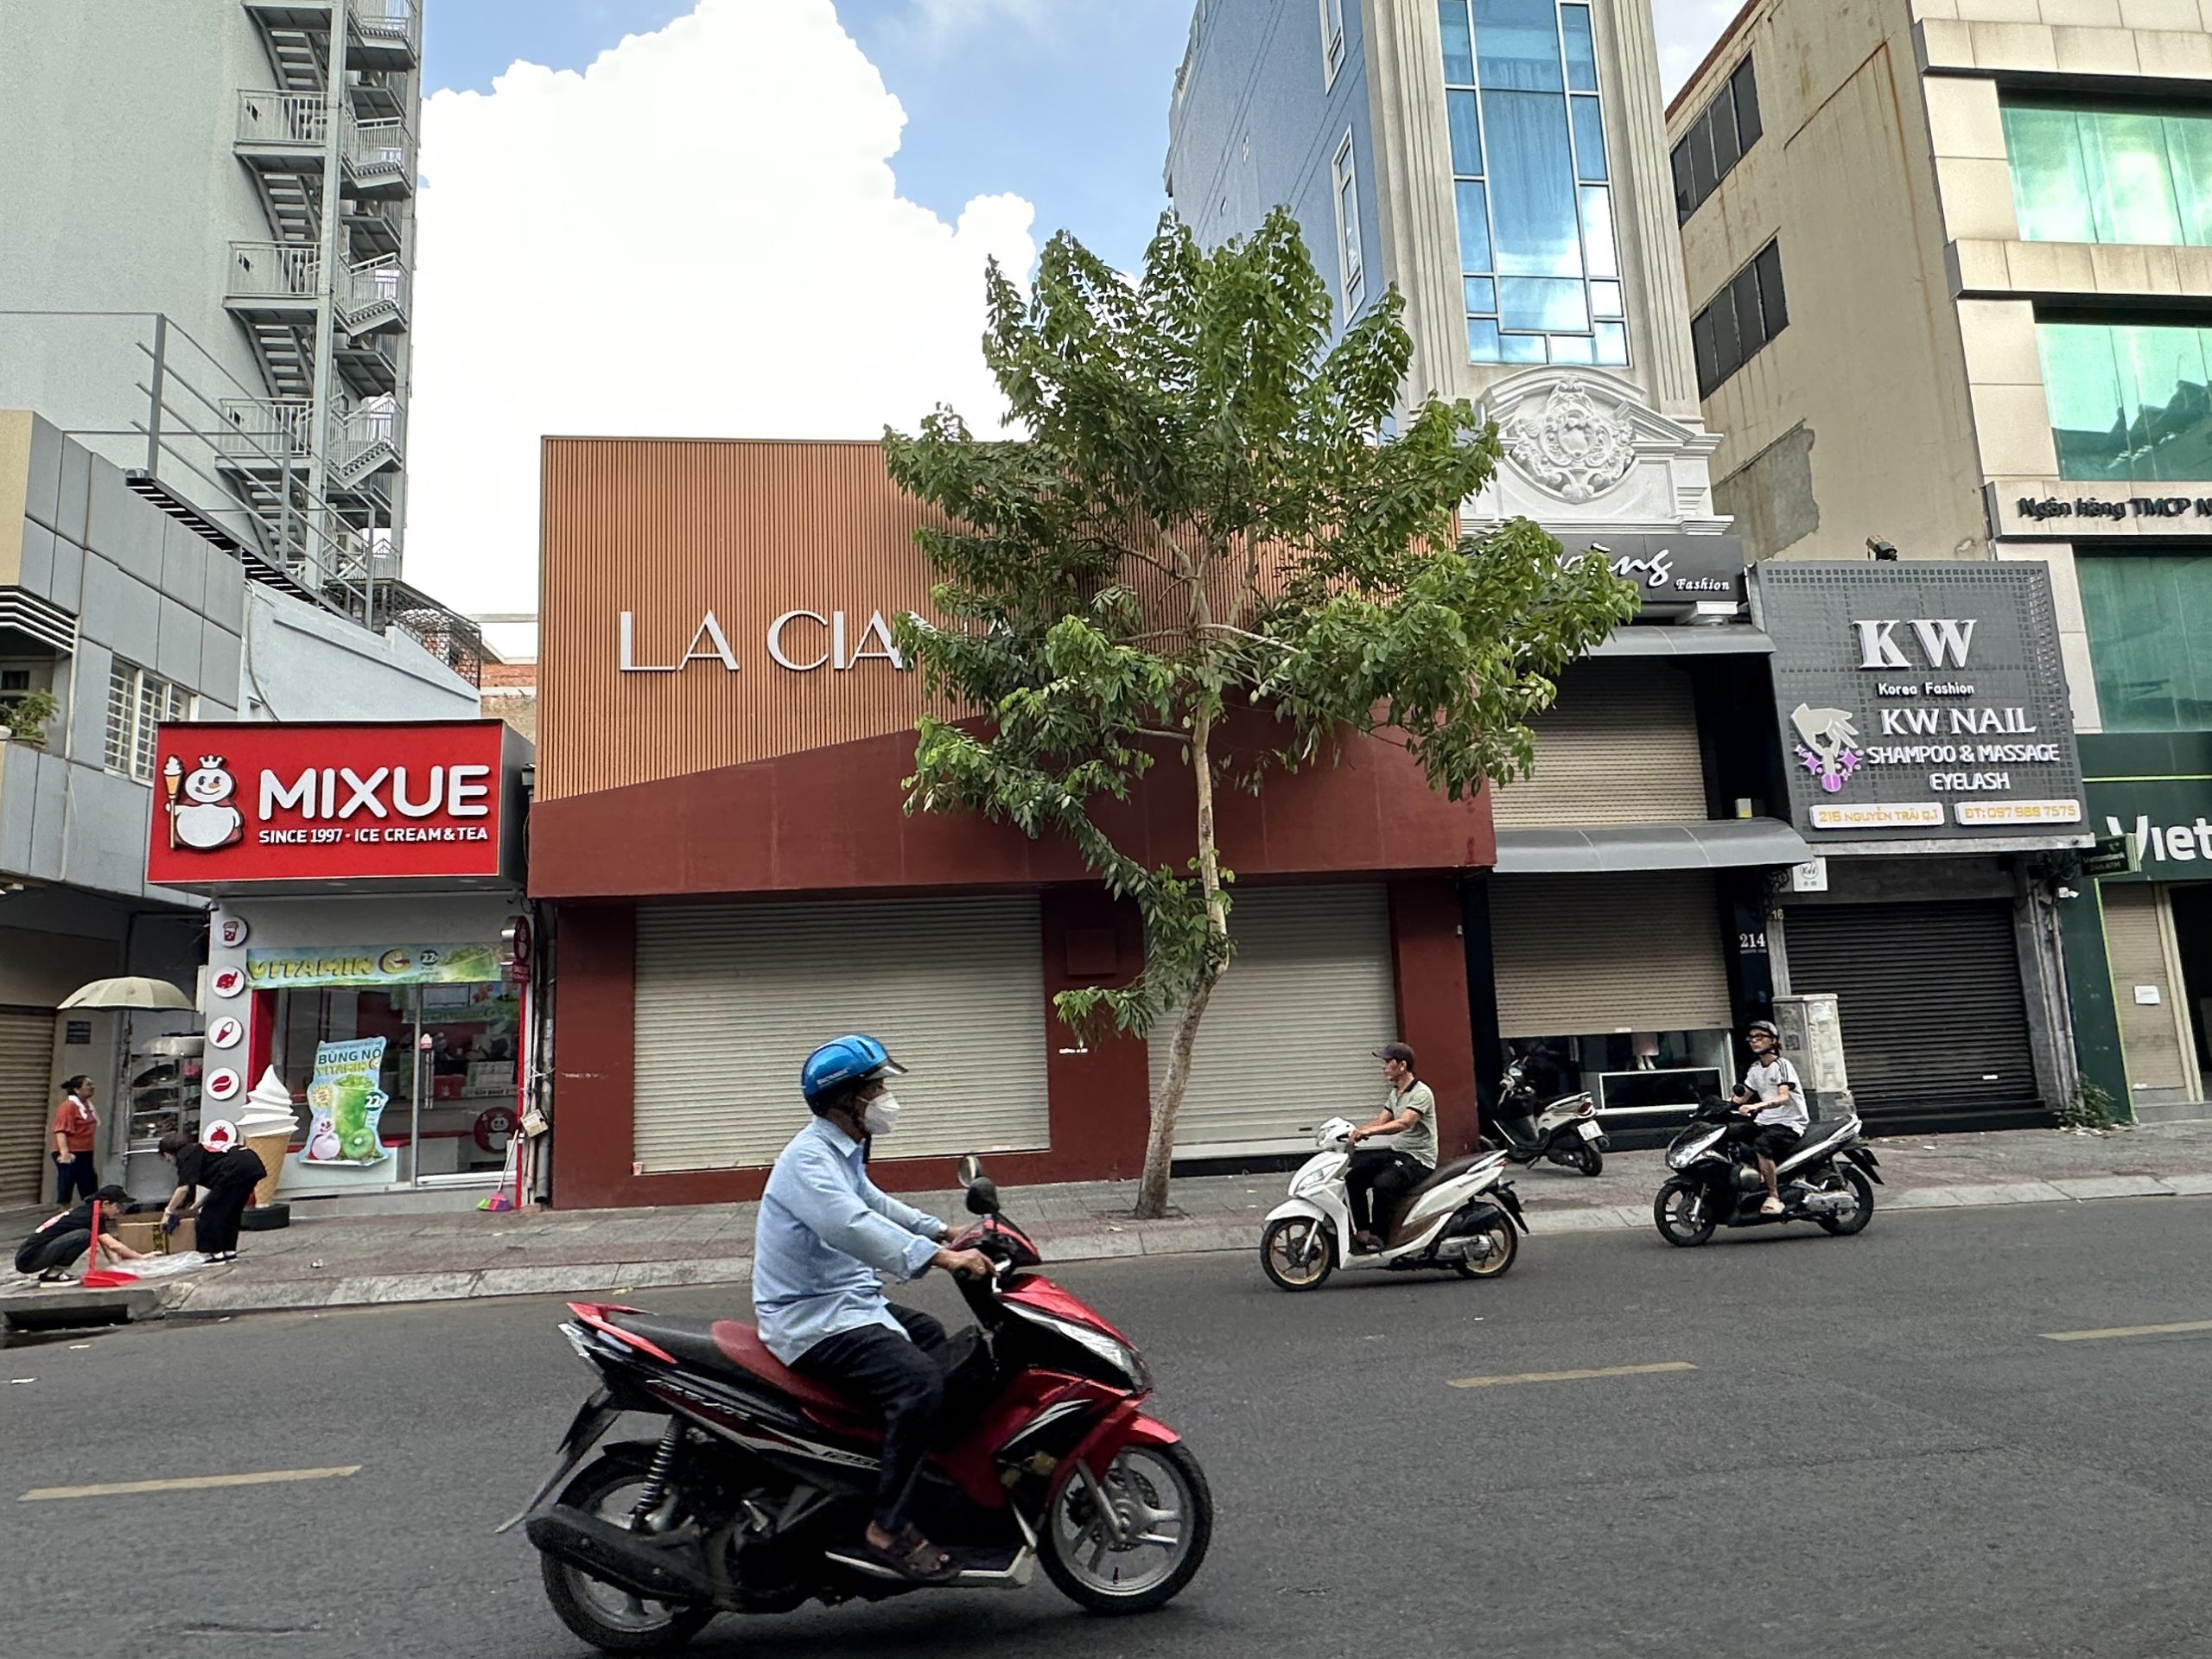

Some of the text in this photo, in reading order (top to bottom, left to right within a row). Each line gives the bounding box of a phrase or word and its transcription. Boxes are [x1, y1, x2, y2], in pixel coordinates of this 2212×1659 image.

[2017, 496, 2073, 522] Ngân
[2075, 497, 2127, 522] hàng
[2129, 497, 2192, 518] TMCP
[1675, 577, 1730, 592] Fashion
[620, 610, 741, 672] LA
[1853, 619, 1978, 670] KW
[1878, 682, 1975, 696] Korea Fashion
[1879, 707, 2037, 735] KW NAIL
[1866, 743, 2061, 765] SHAMPOO & MASSAGE
[259, 765, 490, 821] MIXUE
[1929, 772, 2012, 791] EYELASH
[258, 829, 308, 843] SINCE
[310, 828, 343, 842] 1997
[354, 828, 380, 842] ICE
[1739, 933, 1766, 948] 214
[246, 954, 376, 980] VITAMIN
